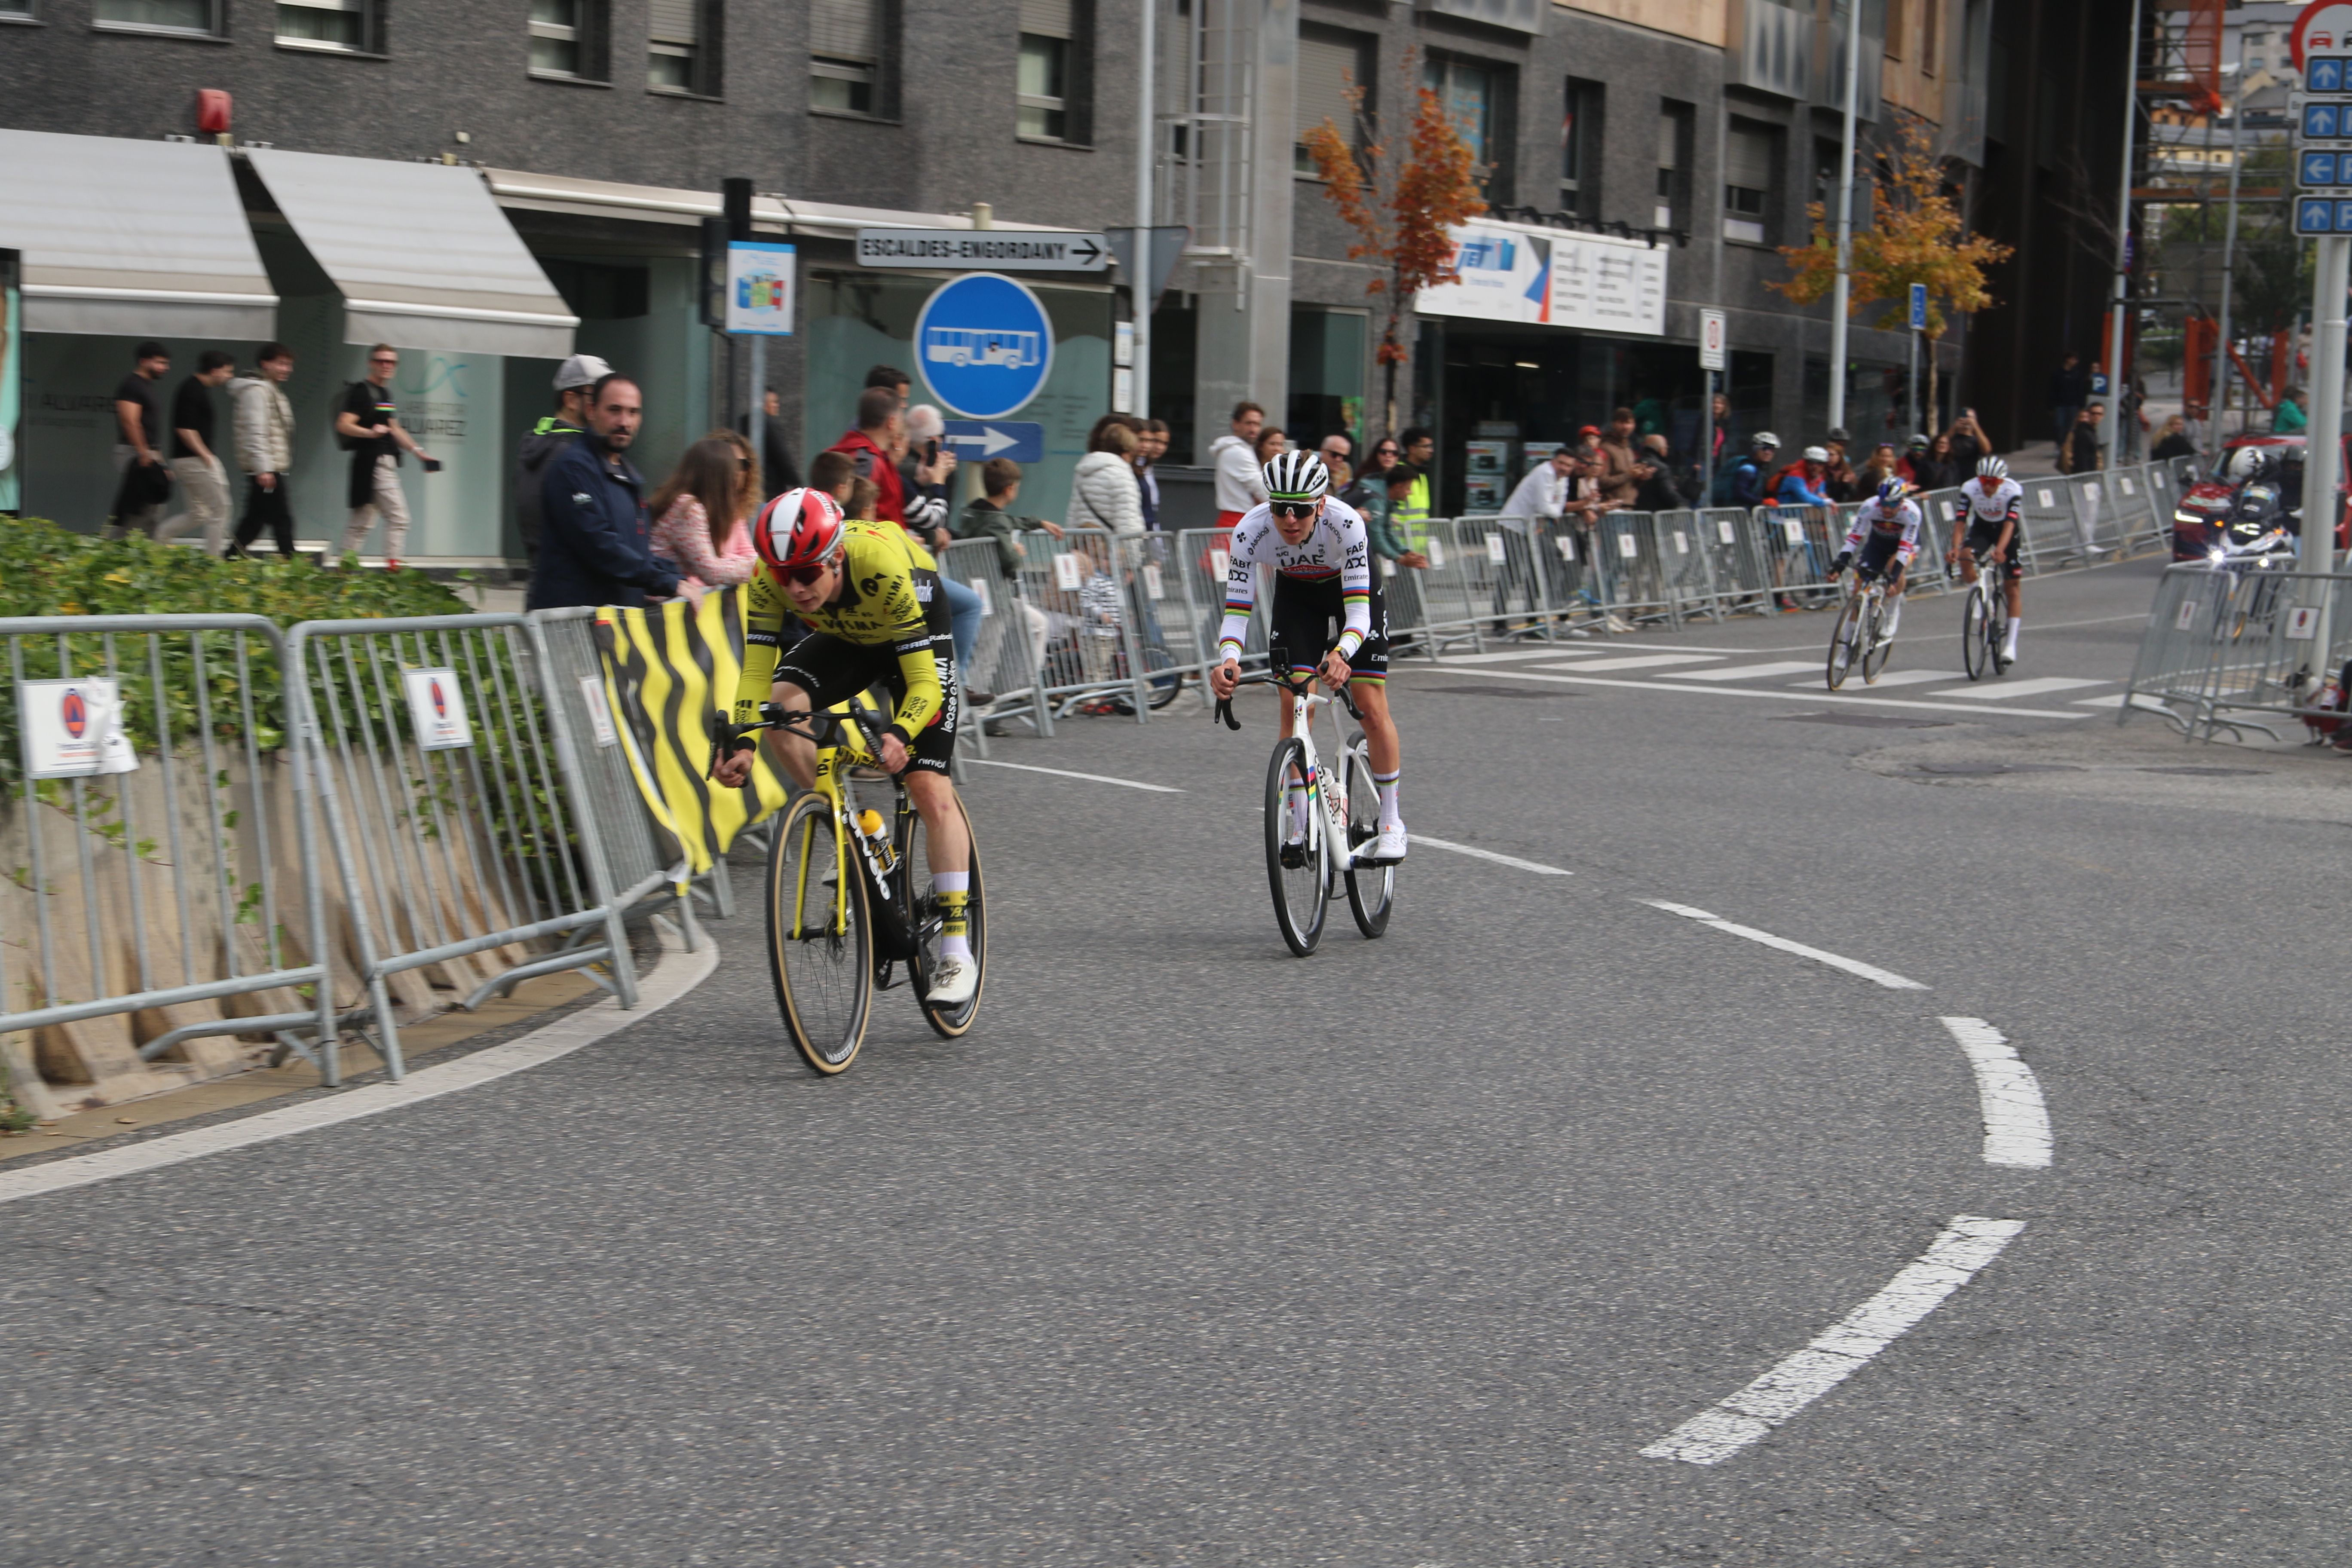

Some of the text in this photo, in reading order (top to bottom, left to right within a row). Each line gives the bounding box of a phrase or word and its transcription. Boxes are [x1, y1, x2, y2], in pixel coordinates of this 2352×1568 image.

[862, 239, 1068, 260] ESCALDES-ENGORDANY
[1281, 554, 1326, 567] UAE
[1344, 573, 1369, 582] Emirate
[883, 575, 905, 606] VISMA
[895, 639, 931, 652] SRAM
[1314, 753, 1336, 825] COLNAGO
